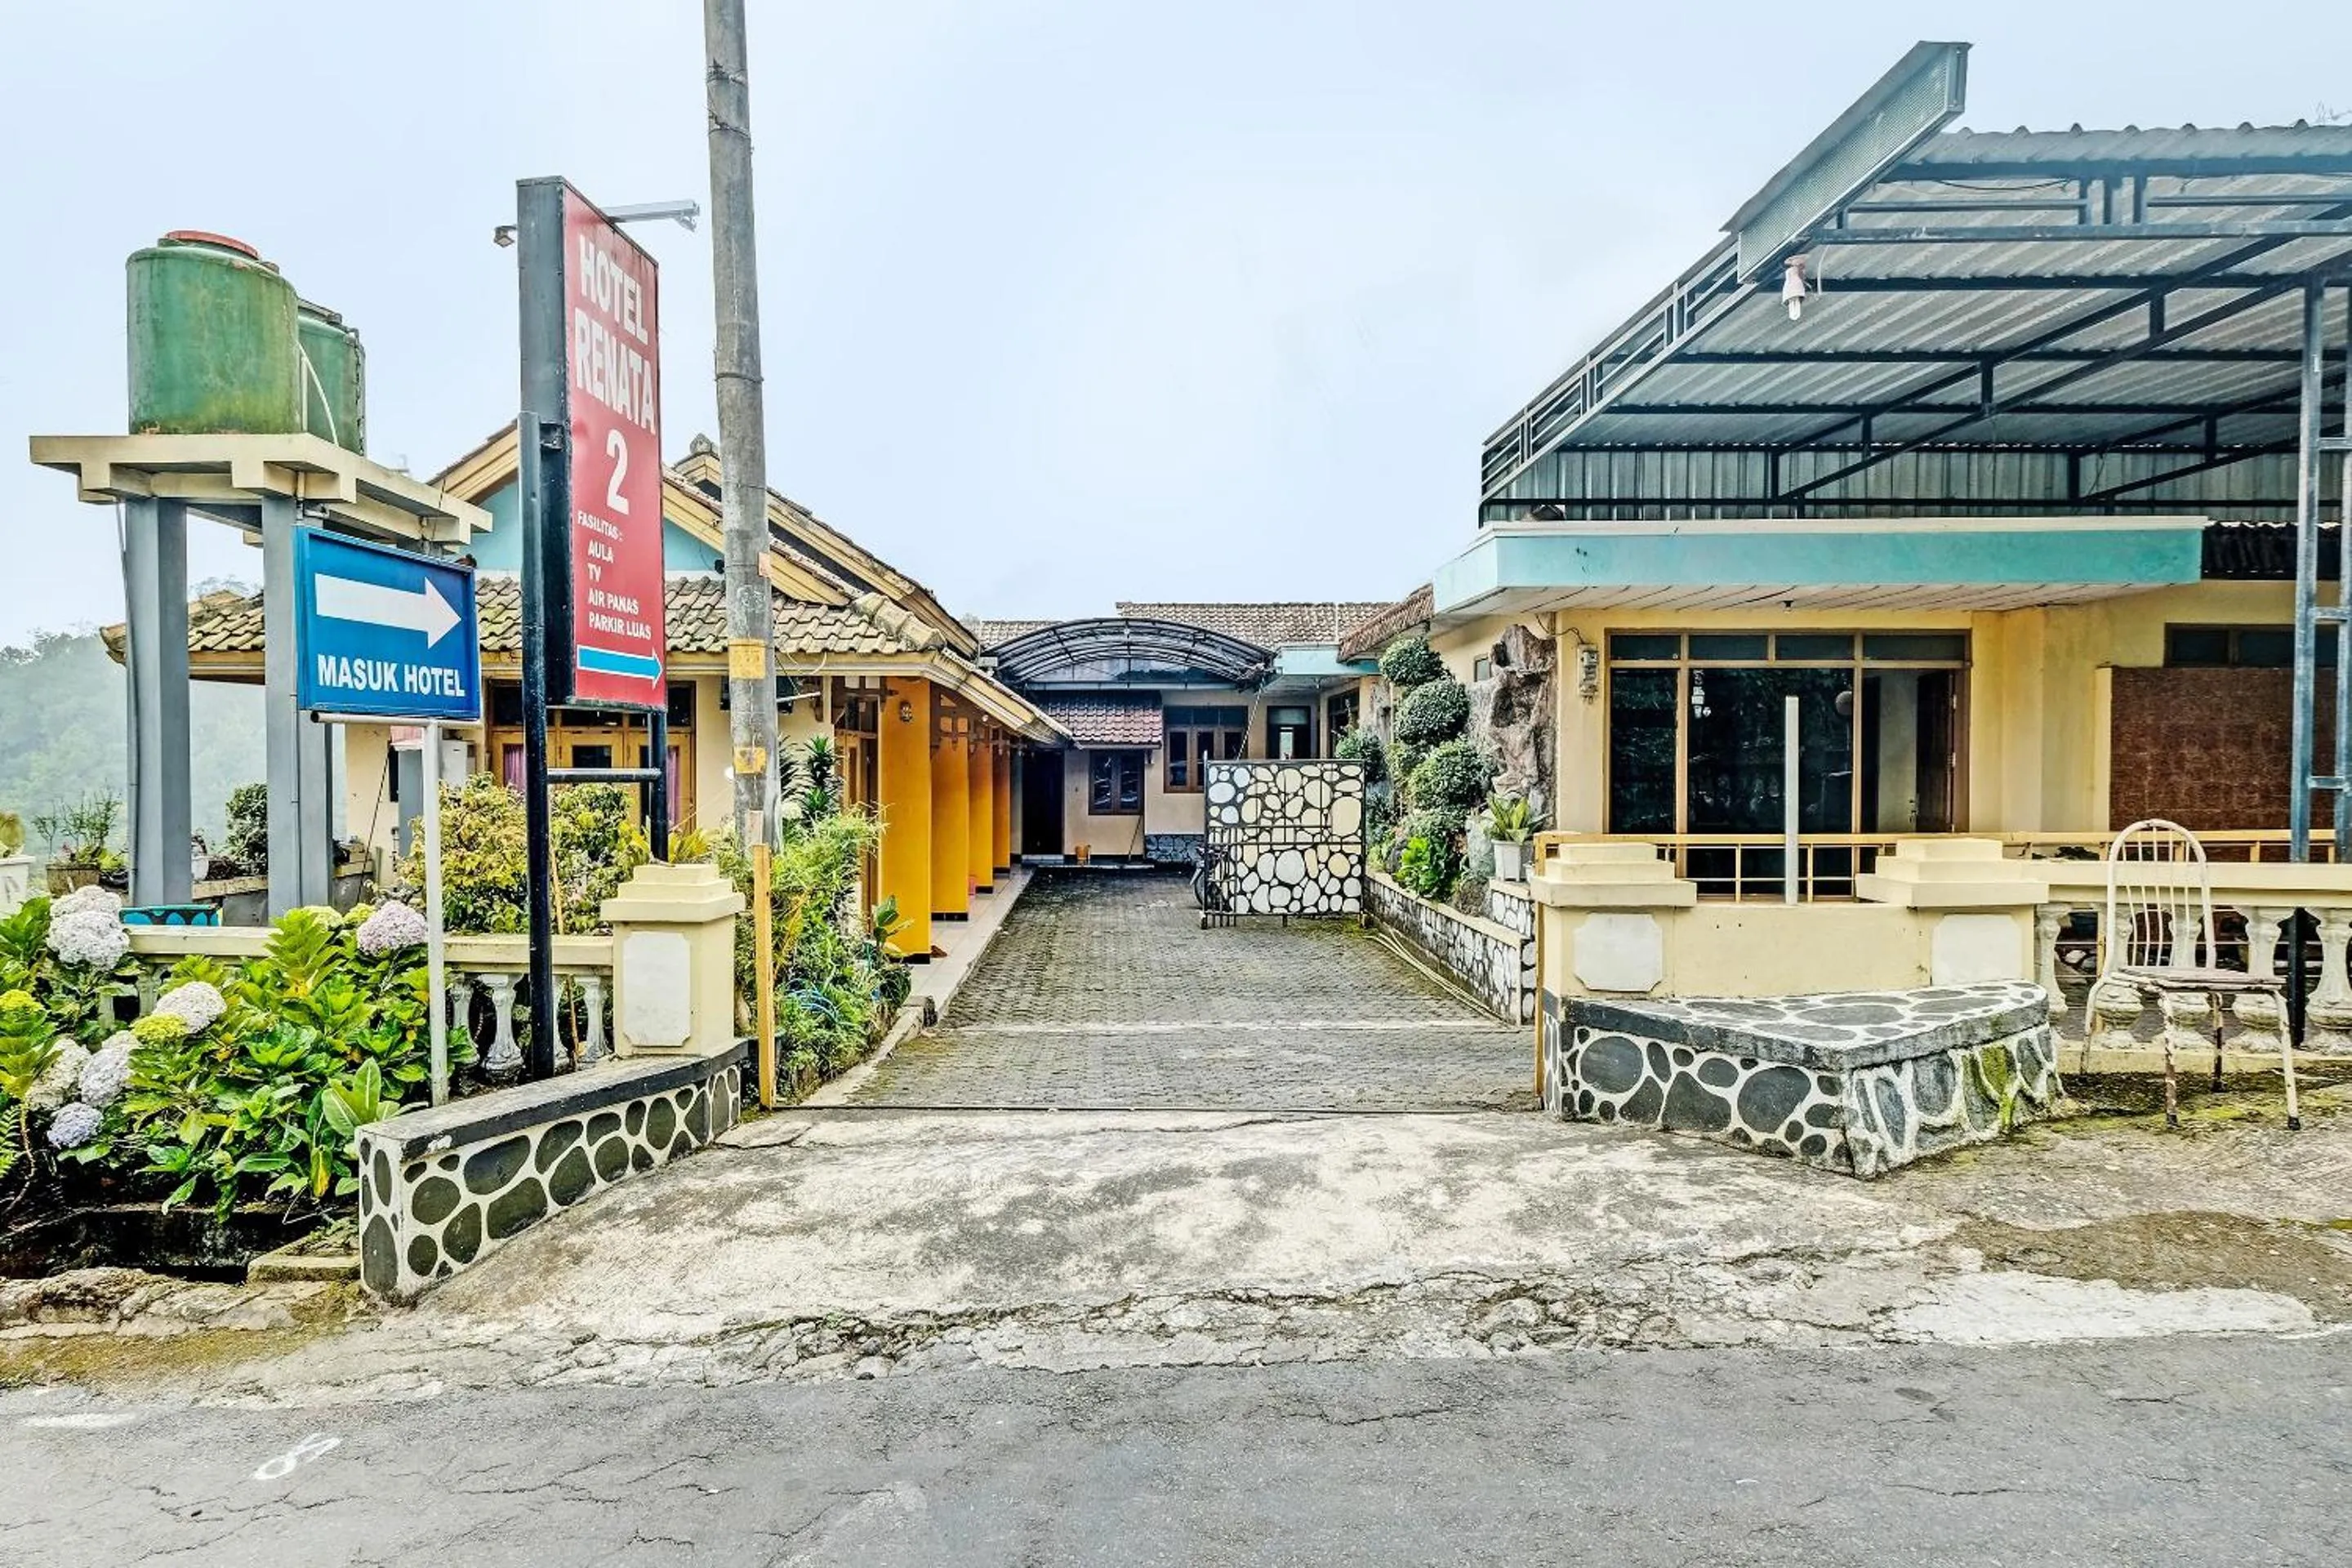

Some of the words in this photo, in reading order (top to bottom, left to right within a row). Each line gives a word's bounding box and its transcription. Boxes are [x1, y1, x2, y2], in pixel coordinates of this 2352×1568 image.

[579, 234, 648, 345] HOTEL
[575, 307, 656, 434] RENATA
[606, 429, 630, 515] 2
[588, 539, 614, 564] AULA
[588, 563, 601, 582] TV
[589, 588, 604, 608] AIR
[607, 593, 639, 615] PANAS
[589, 611, 625, 635] PARKIR
[626, 621, 651, 640] LUAS
[318, 654, 399, 692] MASUK
[404, 664, 466, 697] HOTEL
